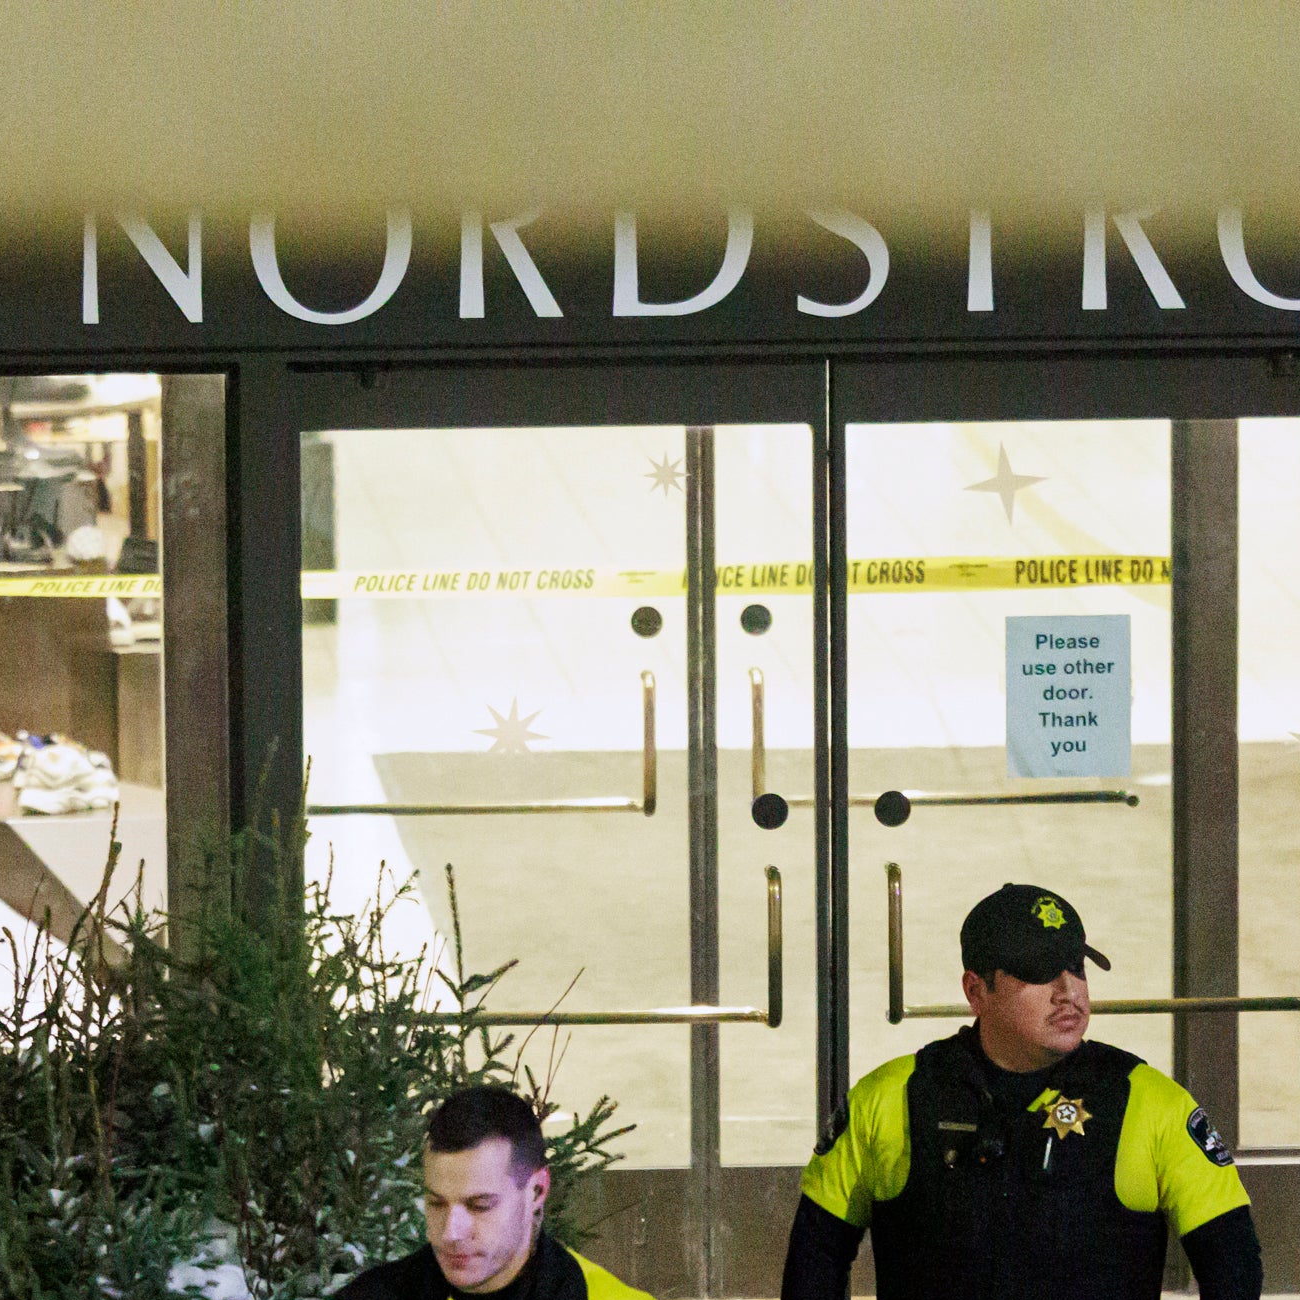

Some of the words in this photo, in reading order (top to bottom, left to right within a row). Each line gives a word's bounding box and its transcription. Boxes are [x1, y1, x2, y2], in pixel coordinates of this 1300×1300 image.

[751, 564, 789, 587] LINE
[866, 560, 925, 585] CROSS
[1015, 559, 1078, 584] POLICE
[1085, 558, 1124, 583] LINE
[1130, 559, 1154, 583] DO
[31, 580, 94, 593] POLICE
[99, 579, 138, 593] LINE
[354, 574, 417, 592] POLICE
[422, 573, 461, 591] LINE
[467, 572, 491, 591] DO
[496, 571, 532, 590] NOT
[537, 569, 596, 589] CROSS
[1036, 633, 1100, 649] Please
[1022, 663, 1057, 676] use
[1063, 659, 1115, 675] other
[1043, 685, 1094, 701] door.
[1038, 711, 1099, 728] Thank
[1051, 740, 1087, 757] you
